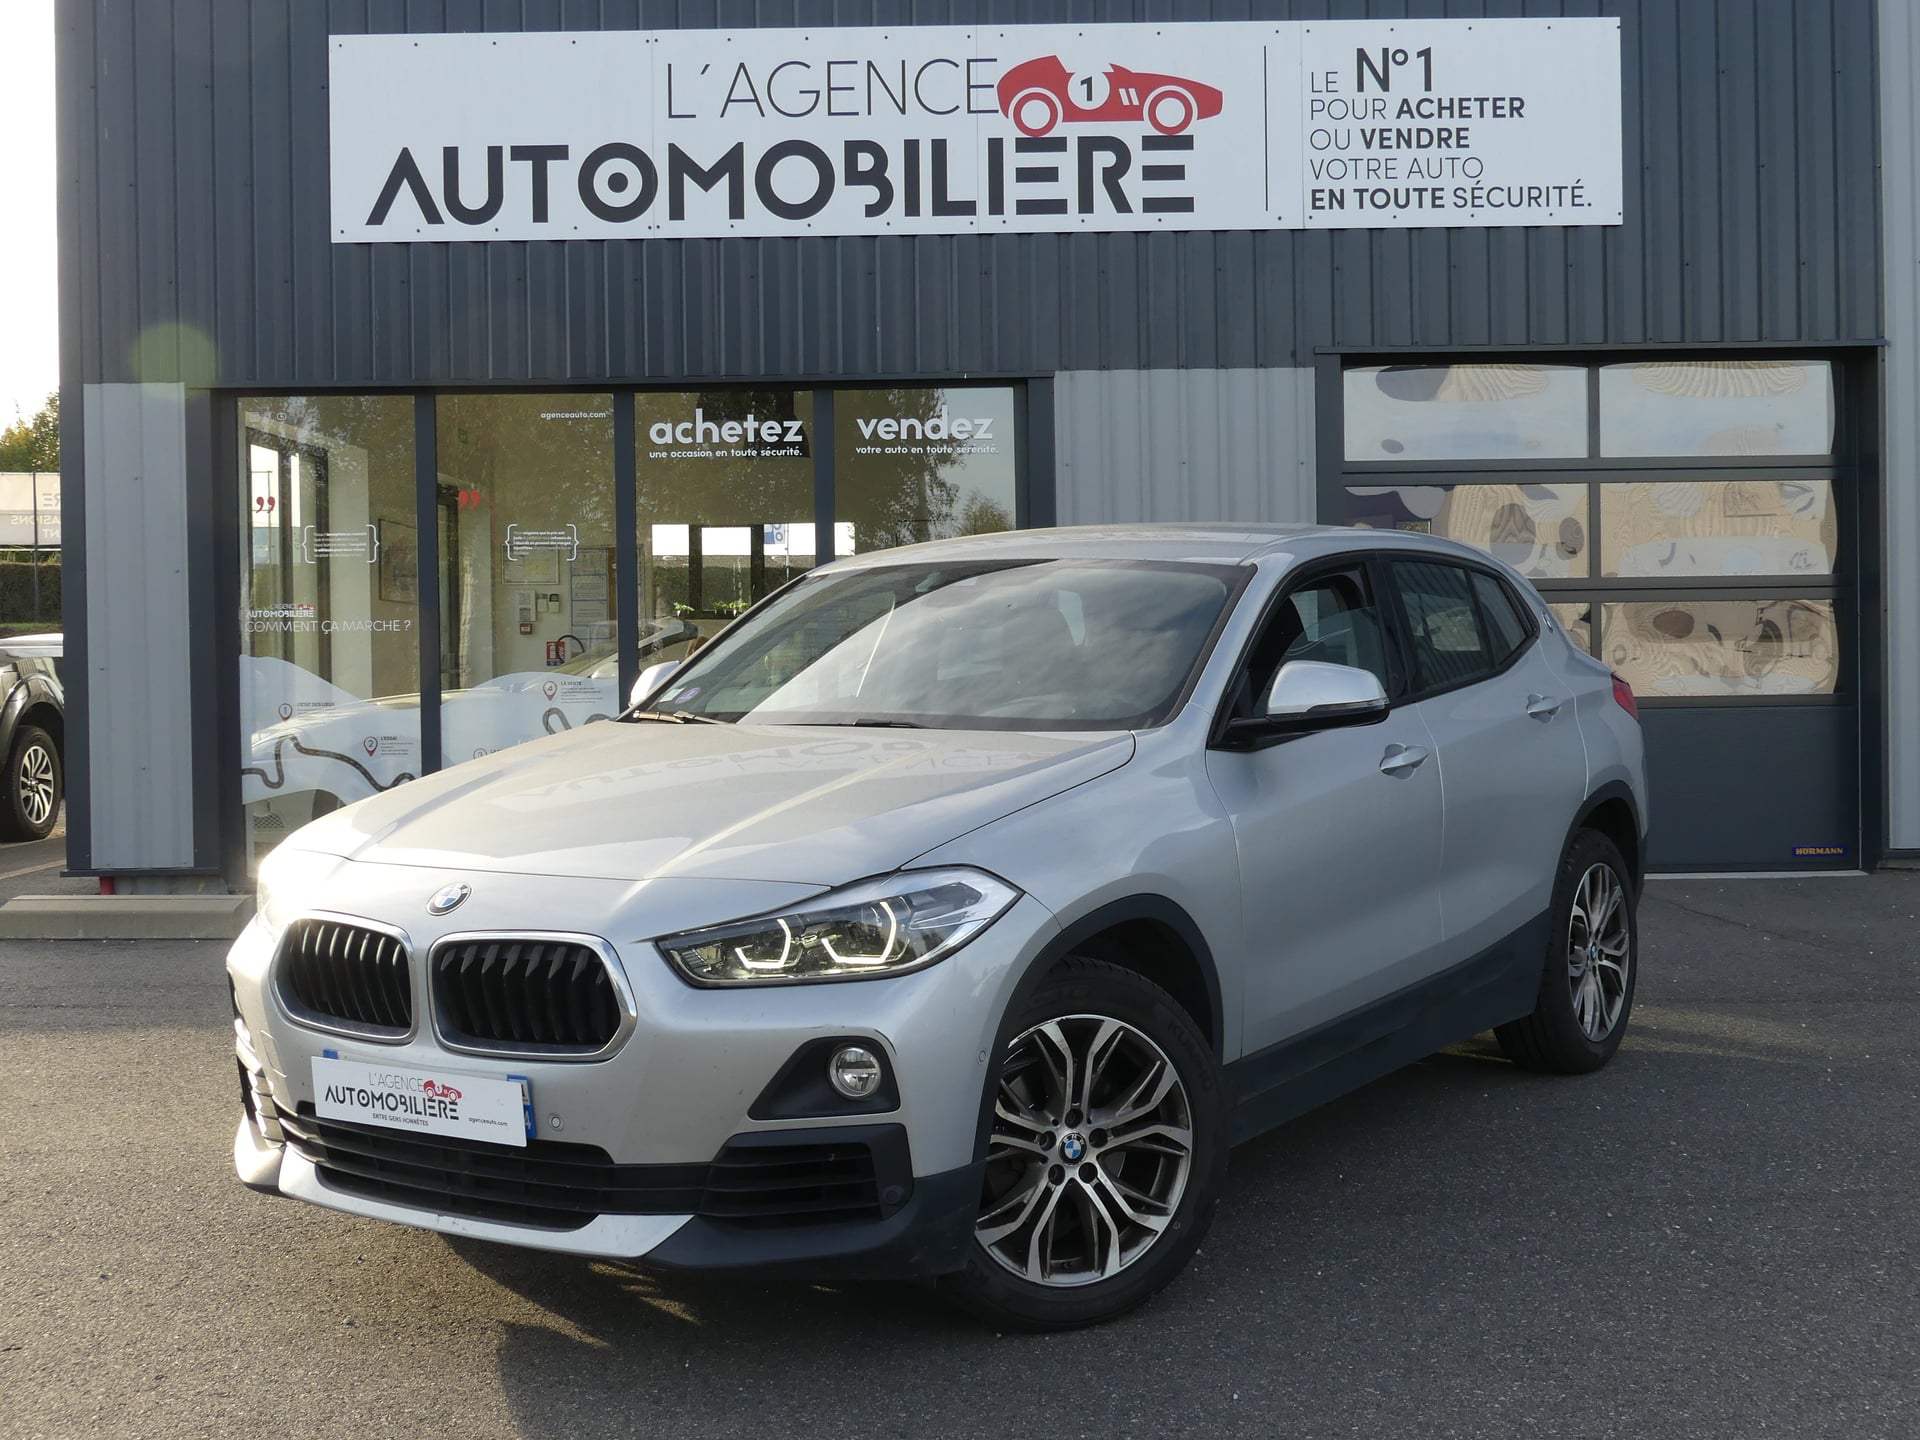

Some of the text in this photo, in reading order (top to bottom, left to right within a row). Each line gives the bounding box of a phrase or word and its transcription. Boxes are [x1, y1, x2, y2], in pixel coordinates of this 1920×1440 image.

[667, 57, 999, 119] L'AGENCE
[1311, 71, 1339, 93] LE
[1311, 97, 1526, 120] POUR ACHETER
[1310, 127, 1470, 151] OU VENDRE
[365, 134, 1195, 226] AUTOMOBILIERE
[1310, 157, 1484, 180] VOTRE AUTO
[1311, 178, 1592, 210] EN TOUTE SÉCURITÉ.
[540, 411, 606, 420] agenceauto.com
[649, 408, 803, 444] achetez
[856, 404, 994, 440] vendez
[670, 448, 713, 457] occasion
[731, 448, 757, 457] toute
[760, 446, 803, 457] sécurité.
[856, 445, 881, 454] votre
[885, 445, 908, 454] auto
[911, 446, 923, 454] en
[926, 445, 953, 454] toute
[245, 620, 318, 633] COMMENT
[321, 620, 339, 635] ÇA
[343, 620, 400, 632] MARCHE
[368, 1071, 424, 1093] L'AGENCE
[325, 1084, 460, 1121] AUTOMOBILIERE
[372, 1112, 388, 1121] ENTRE
